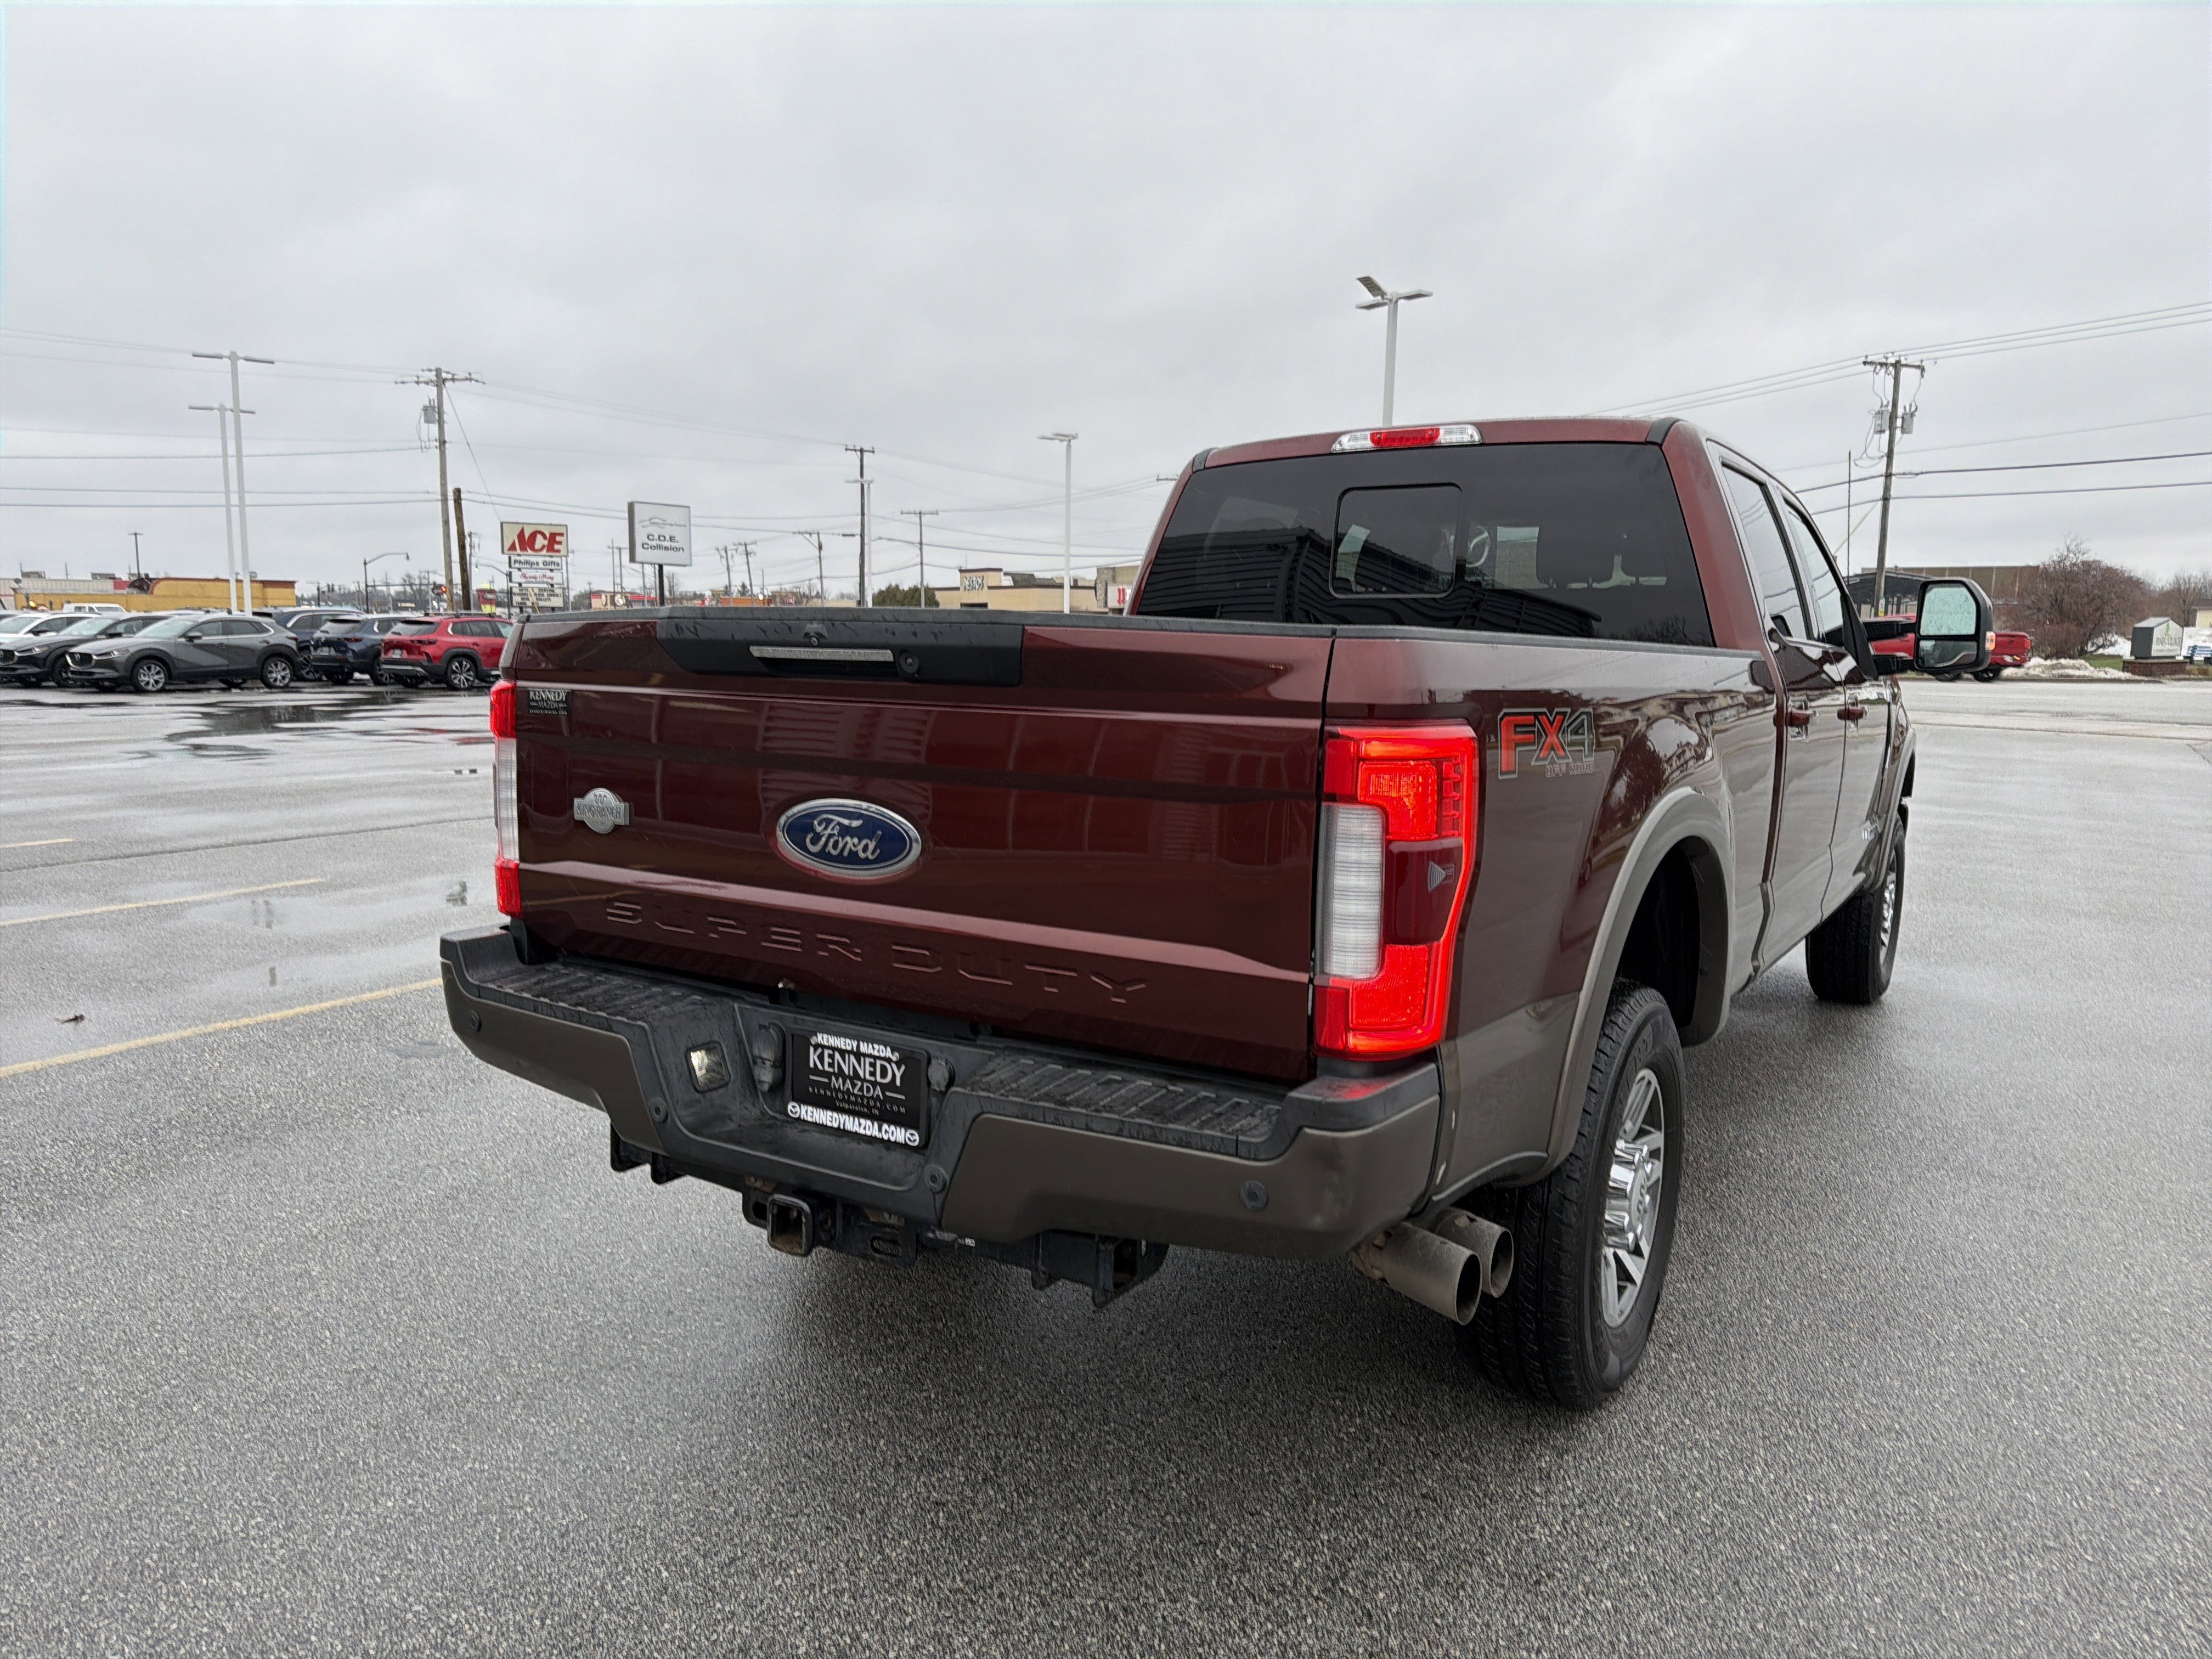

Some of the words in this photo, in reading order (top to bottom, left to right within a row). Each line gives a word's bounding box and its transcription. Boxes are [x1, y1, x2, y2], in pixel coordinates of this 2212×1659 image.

[507, 525, 565, 554] ACE
[641, 542, 685, 552] Collision
[647, 533, 679, 544] C.D.E.
[529, 690, 568, 701] KENNEDY
[538, 701, 558, 709] MAZDA
[1498, 707, 1596, 779] FX4
[1545, 763, 1566, 777] OFF
[1570, 761, 1595, 775] ROAD
[806, 813, 882, 860] Ford
[606, 901, 863, 962] SUPER
[890, 943, 1147, 1003] DUTY
[816, 1032, 857, 1052] KENNEDY
[860, 1040, 893, 1060] MAZDA
[809, 1045, 906, 1087] KENNEDY
[831, 1075, 883, 1100] MAZDA
[800, 1103, 906, 1144] KENNEDYMAZDA.COM
